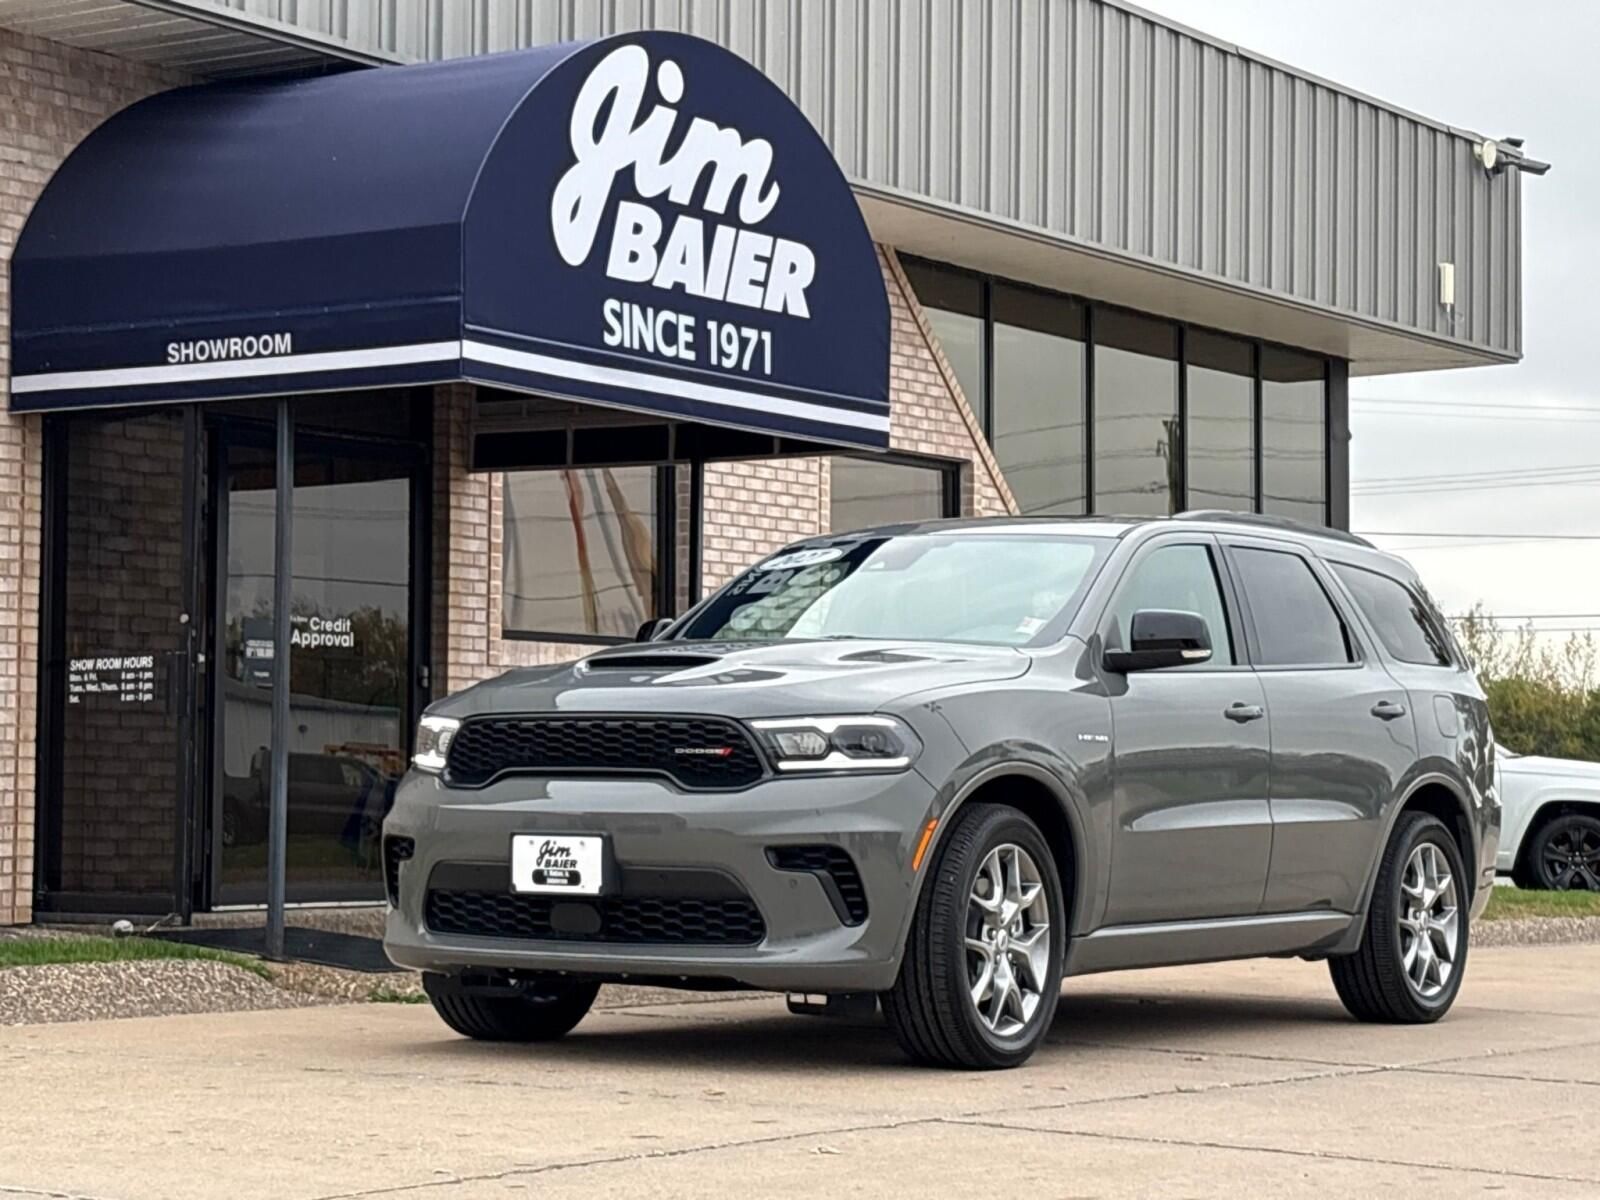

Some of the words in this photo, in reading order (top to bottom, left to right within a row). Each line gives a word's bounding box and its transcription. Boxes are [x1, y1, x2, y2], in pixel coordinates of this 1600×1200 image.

[552, 44, 780, 267] Jim
[606, 200, 816, 319] BAIER
[167, 332, 292, 363] SHOWROOM
[603, 298, 696, 361] SINCE
[706, 320, 772, 375] 1971
[290, 628, 354, 649] Approval
[309, 616, 352, 632] Credit
[70, 659, 95, 671] SHOW
[96, 658, 122, 670] ROOM
[123, 656, 153, 669] HOURS
[536, 839, 571, 868] Jim
[544, 858, 578, 869] BAIER
